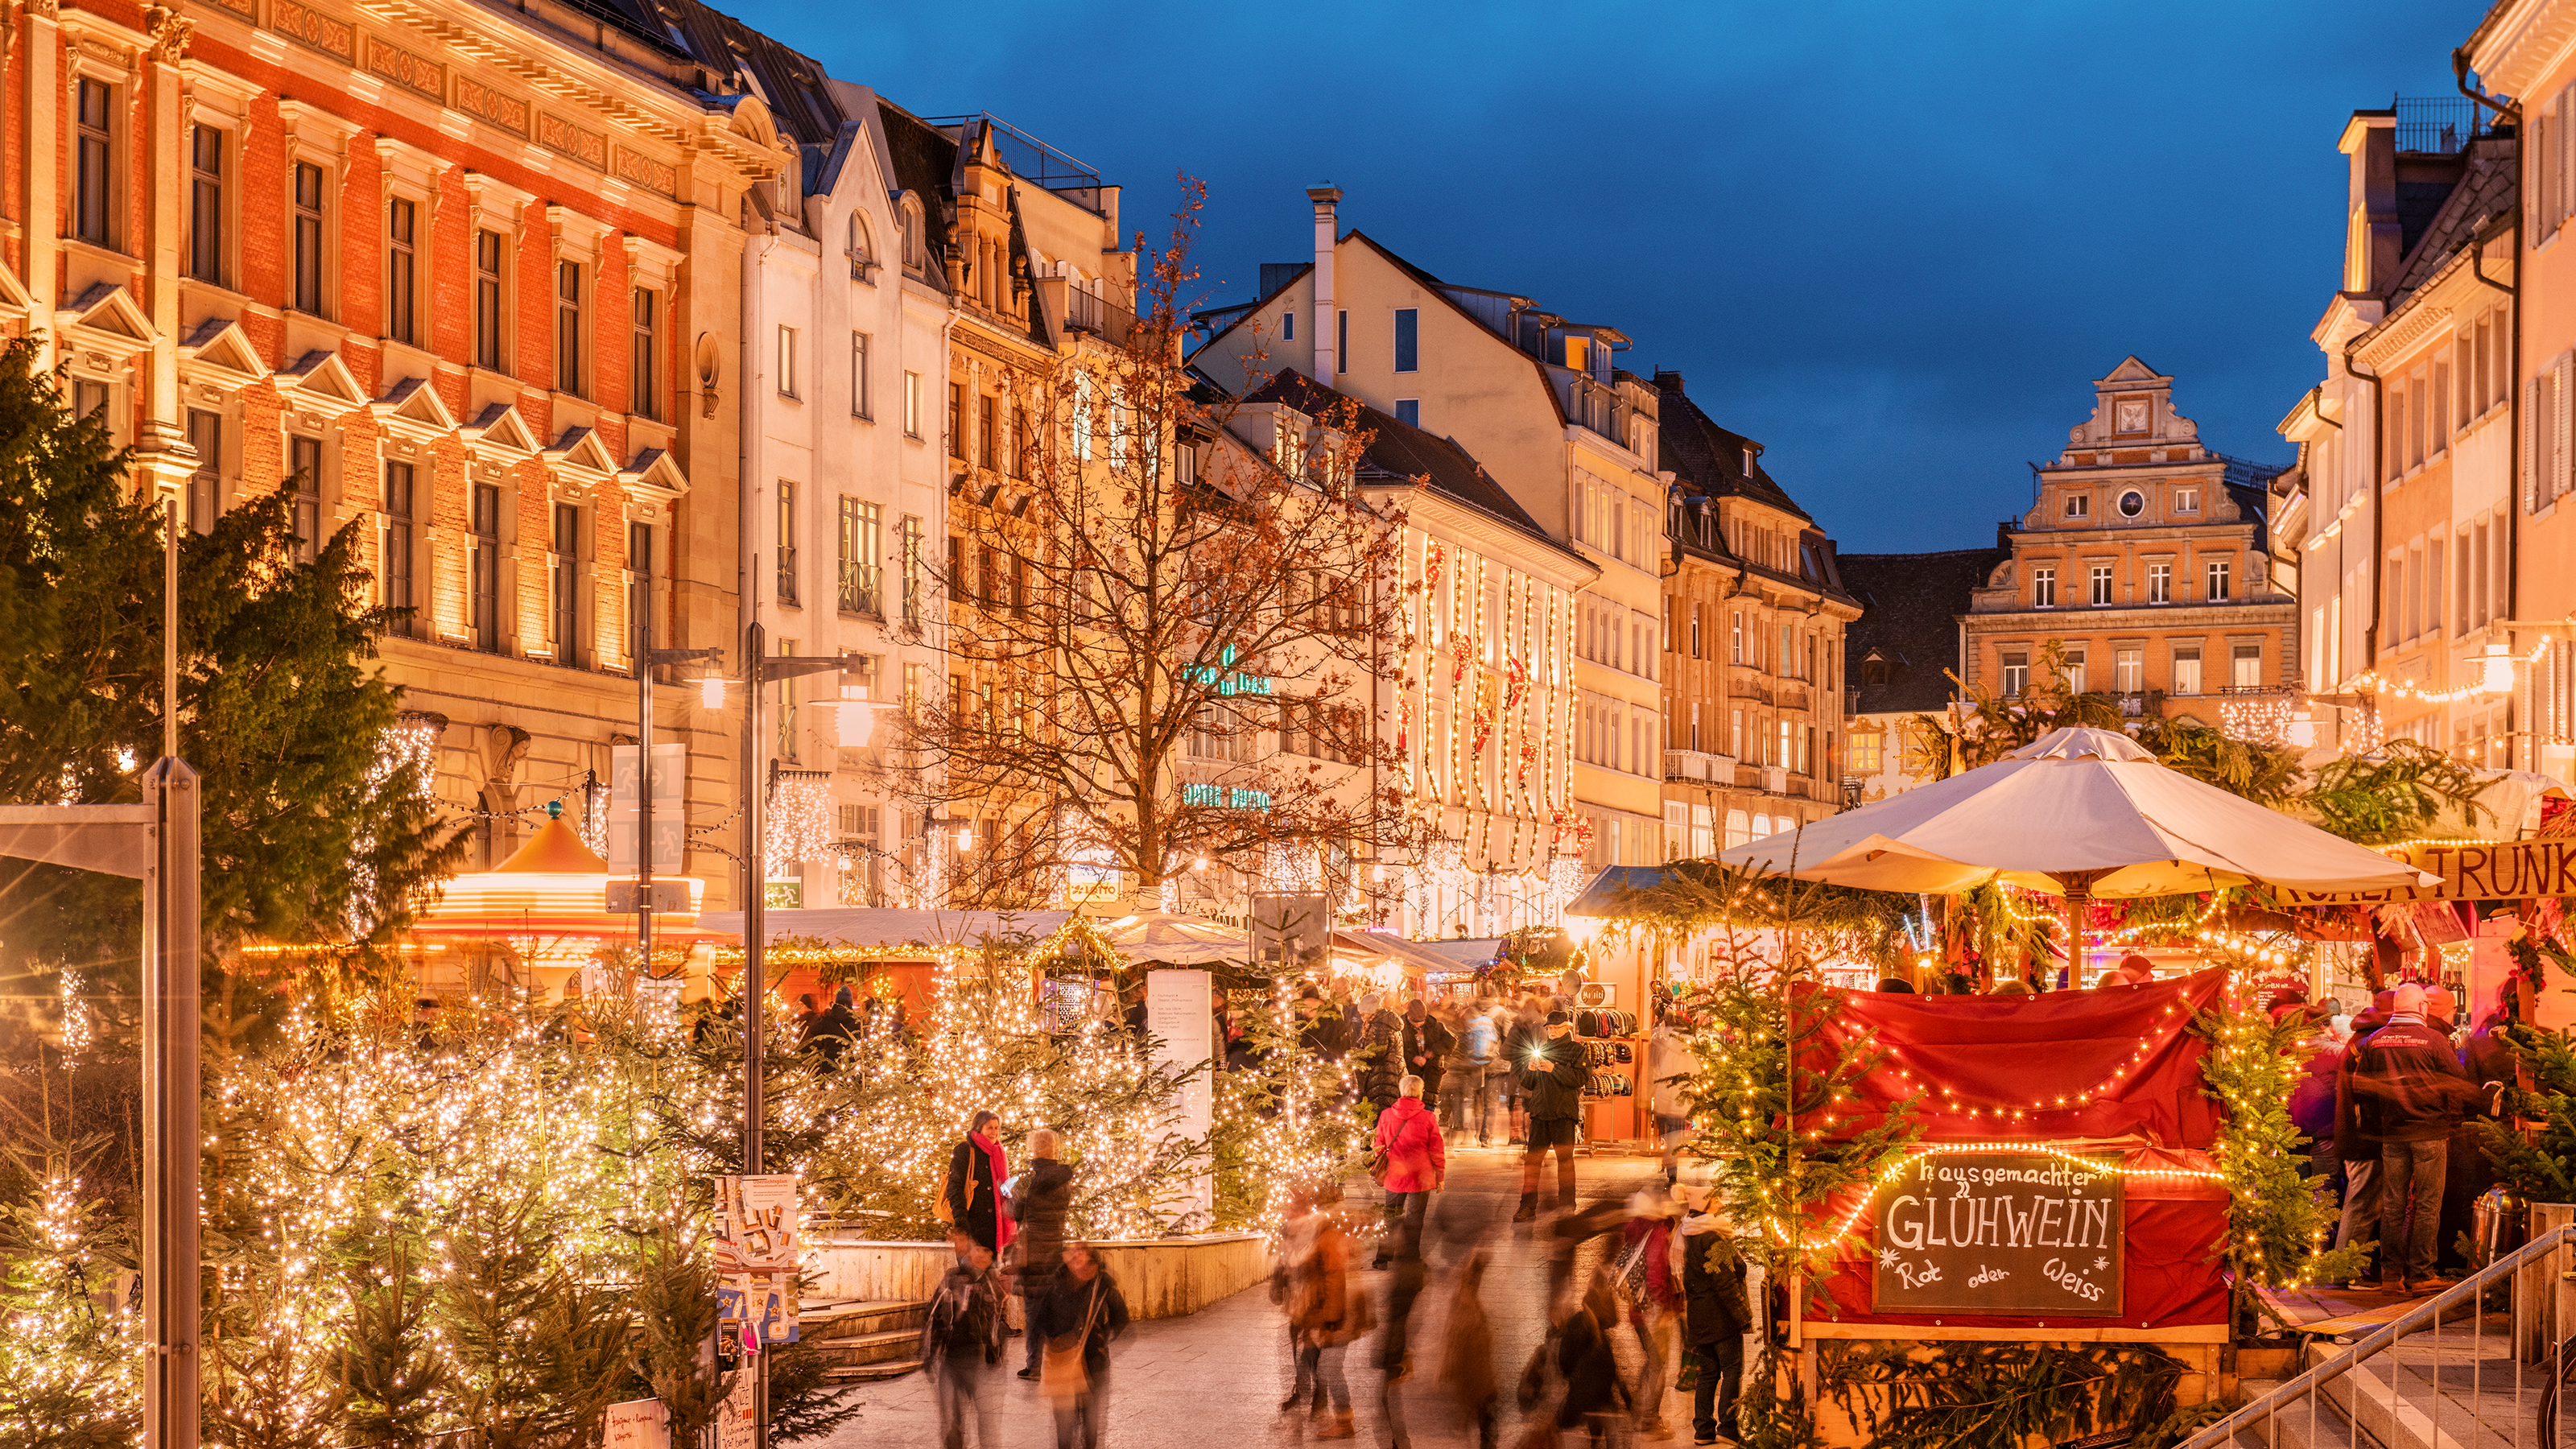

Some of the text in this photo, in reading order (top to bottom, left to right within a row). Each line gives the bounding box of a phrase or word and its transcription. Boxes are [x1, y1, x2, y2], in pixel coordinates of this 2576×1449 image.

[1183, 783, 1270, 813] OPTIK PHOTO
[1085, 886, 1116, 895] LOTTO
[2425, 842, 2576, 898] TRUNK
[1887, 1182, 2112, 1251] GLÜHWEIN
[1894, 1257, 2105, 1302] Rot oder Weiss
